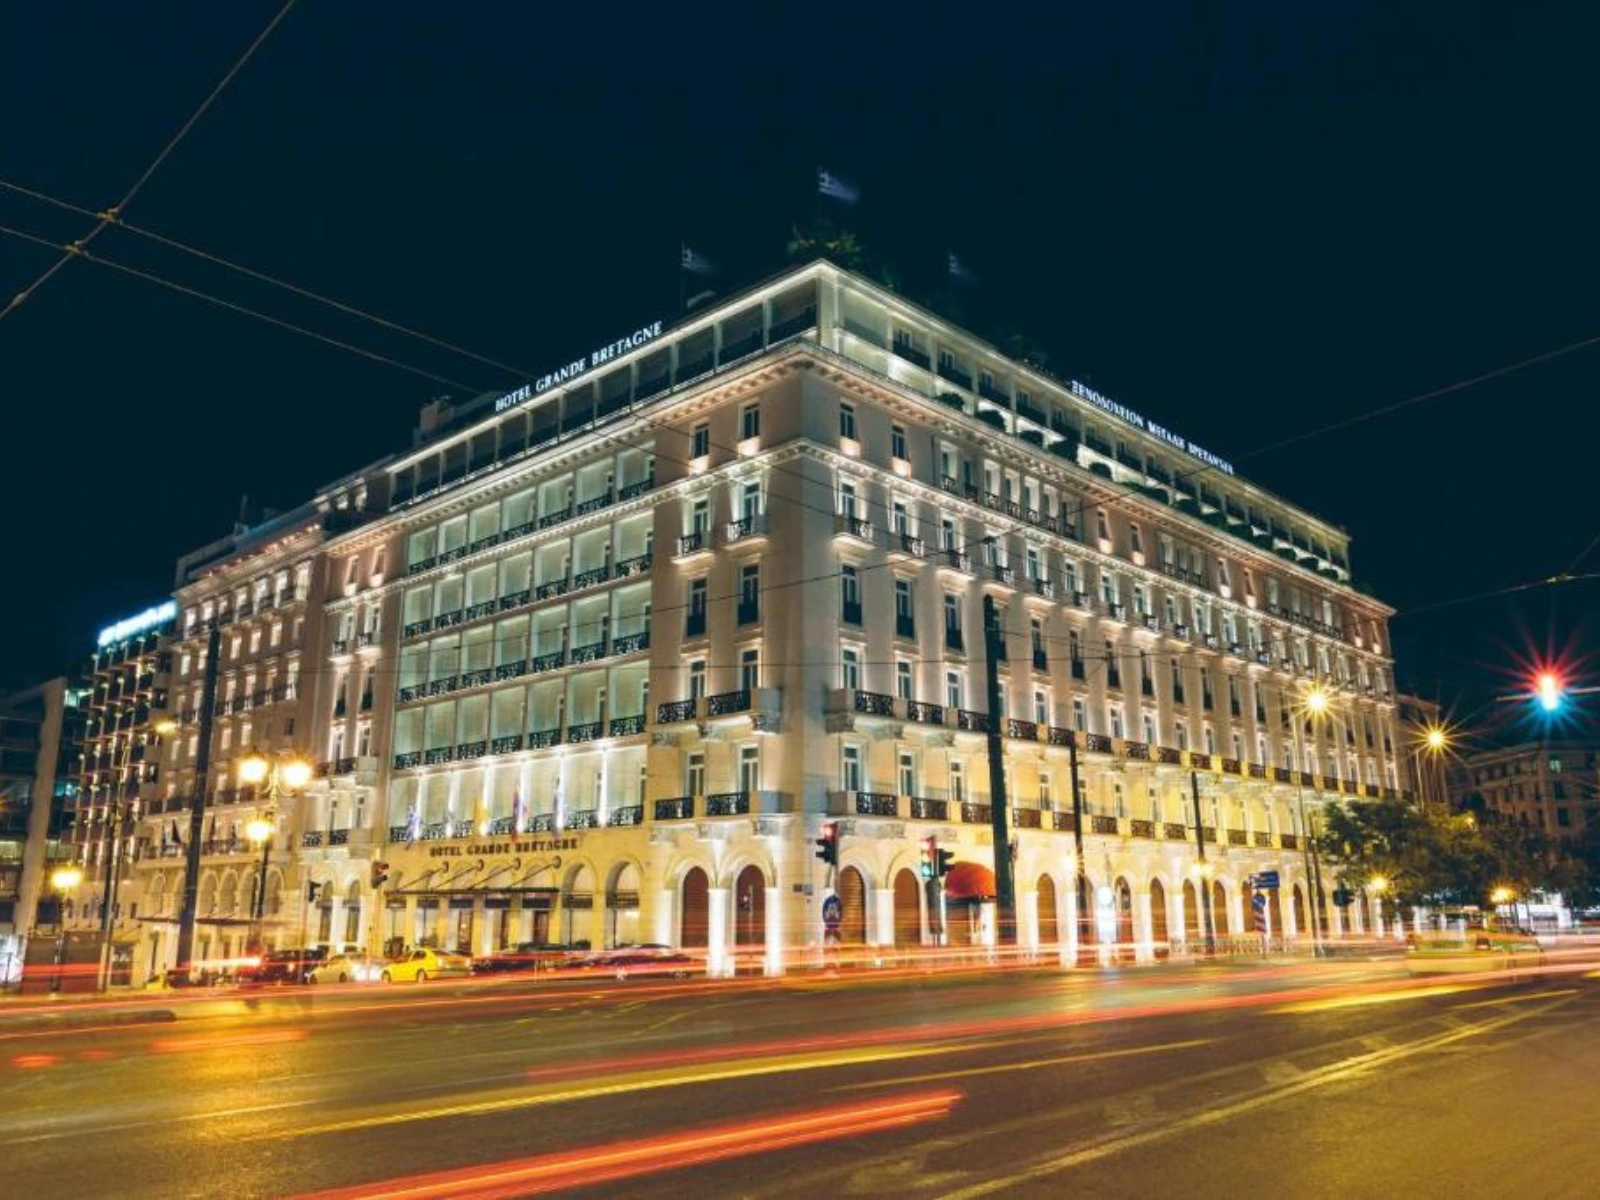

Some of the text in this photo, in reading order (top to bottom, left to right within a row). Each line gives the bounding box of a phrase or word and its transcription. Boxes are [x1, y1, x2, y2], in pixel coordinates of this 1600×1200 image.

[495, 321, 662, 412] HOTEL GRANDE BRETAGNE
[430, 846, 462, 857] HOTEL
[467, 843, 509, 856] GRANDE
